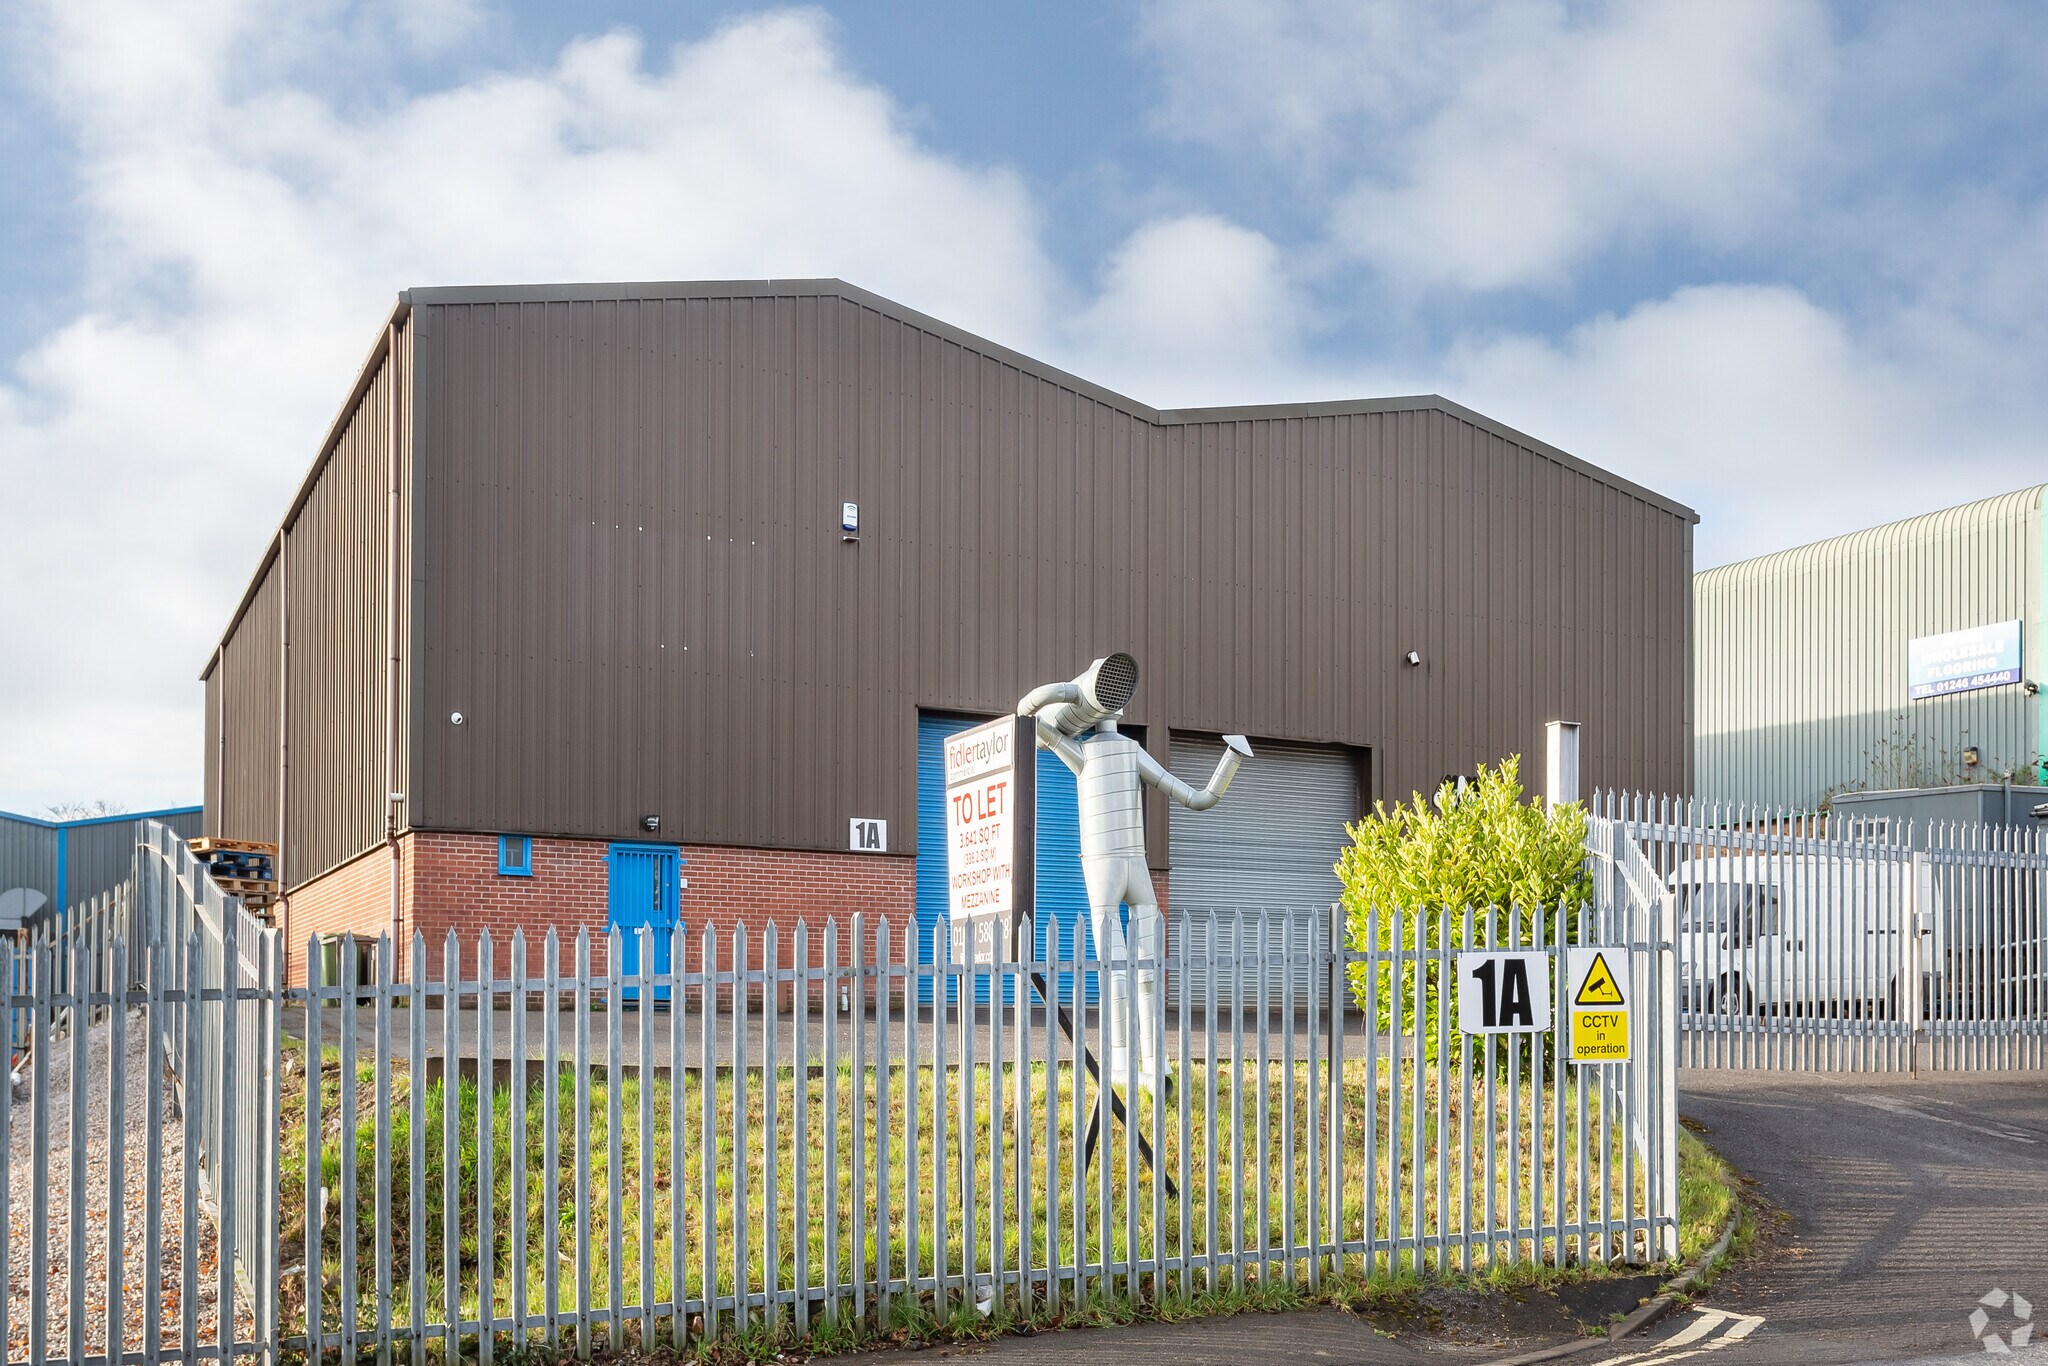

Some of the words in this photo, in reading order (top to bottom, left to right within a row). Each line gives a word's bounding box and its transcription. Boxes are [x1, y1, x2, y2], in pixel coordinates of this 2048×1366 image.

[1914, 686, 1934, 696] TEL
[949, 731, 1008, 769] fidlertaylor
[953, 793, 973, 826] TO
[977, 781, 1007, 820] LET
[855, 821, 881, 849] 1A
[979, 826, 990, 845] SQ
[991, 823, 1001, 841] FT
[951, 868, 991, 890] WORKSHOP
[992, 863, 1011, 882] WITH
[961, 888, 1000, 909] MEZZANINE
[1472, 958, 1534, 1027] 1A
[1582, 1015, 1619, 1028] CCTV
[1596, 1030, 1606, 1041] in
[1577, 1043, 1626, 1057] operation
